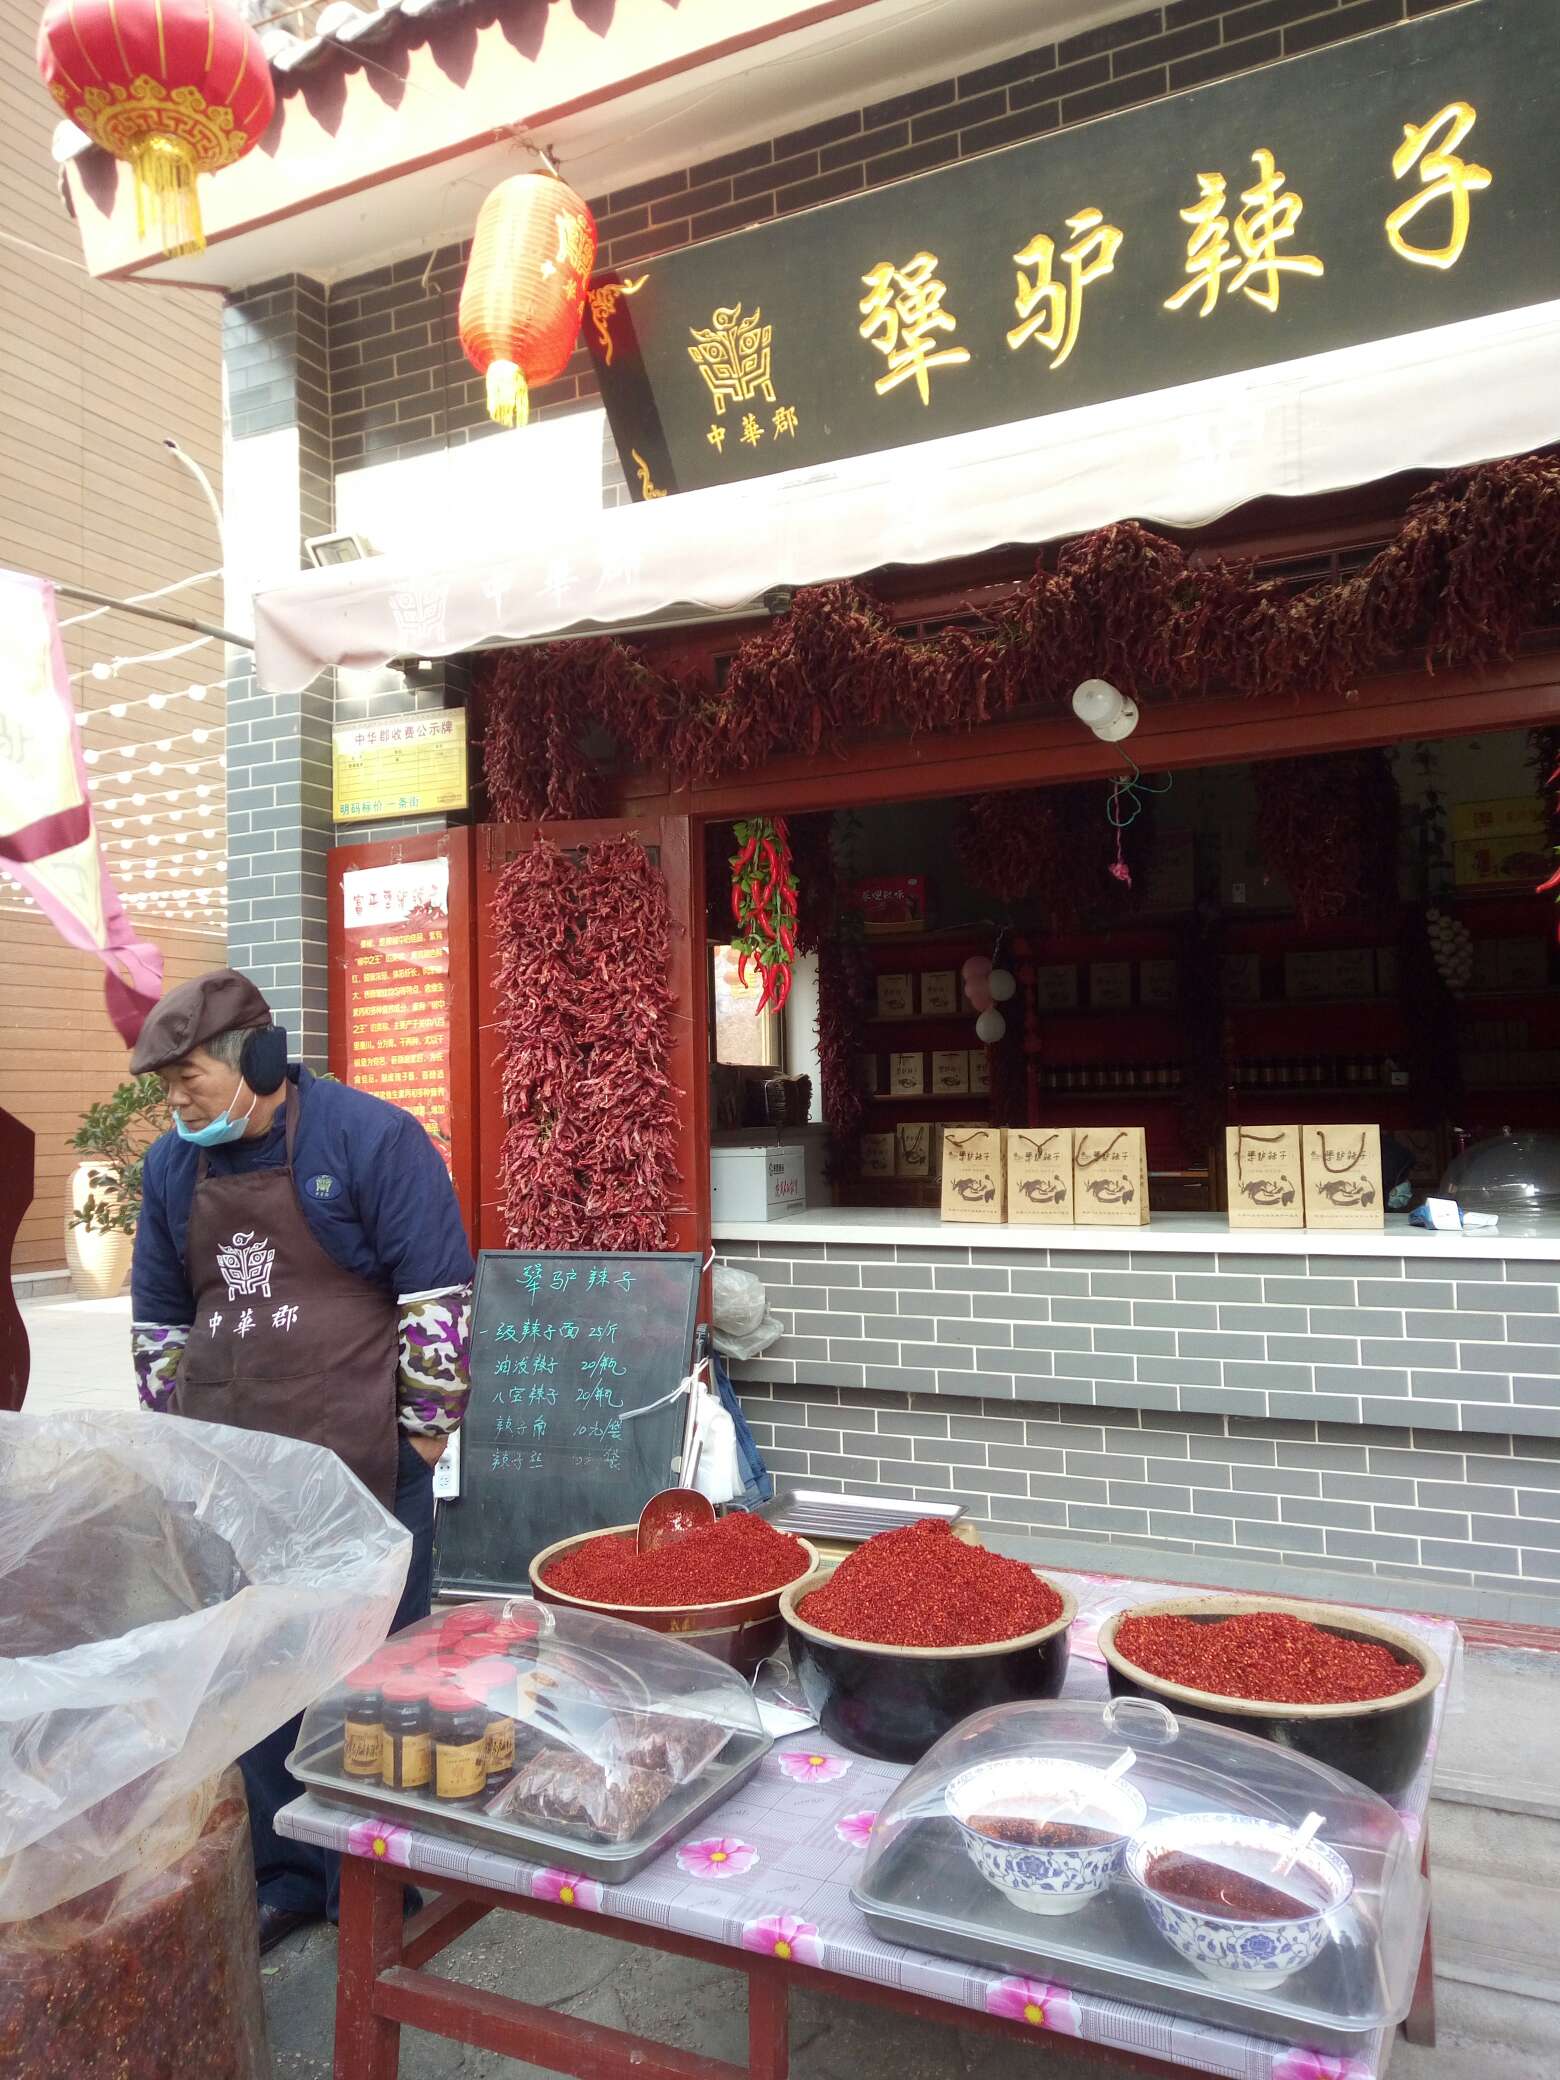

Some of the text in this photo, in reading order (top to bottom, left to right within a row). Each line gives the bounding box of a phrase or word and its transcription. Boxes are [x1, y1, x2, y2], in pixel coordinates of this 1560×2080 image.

[858, 101, 1493, 405] 犟驴辣子
[706, 404, 799, 453] 中華郡
[354, 720, 454, 746] 中华郡收费公示牌
[515, 1263, 637, 1306] 犟驴辣子
[208, 1303, 300, 1340] 中華郡
[588, 1319, 618, 1344] 25/斤
